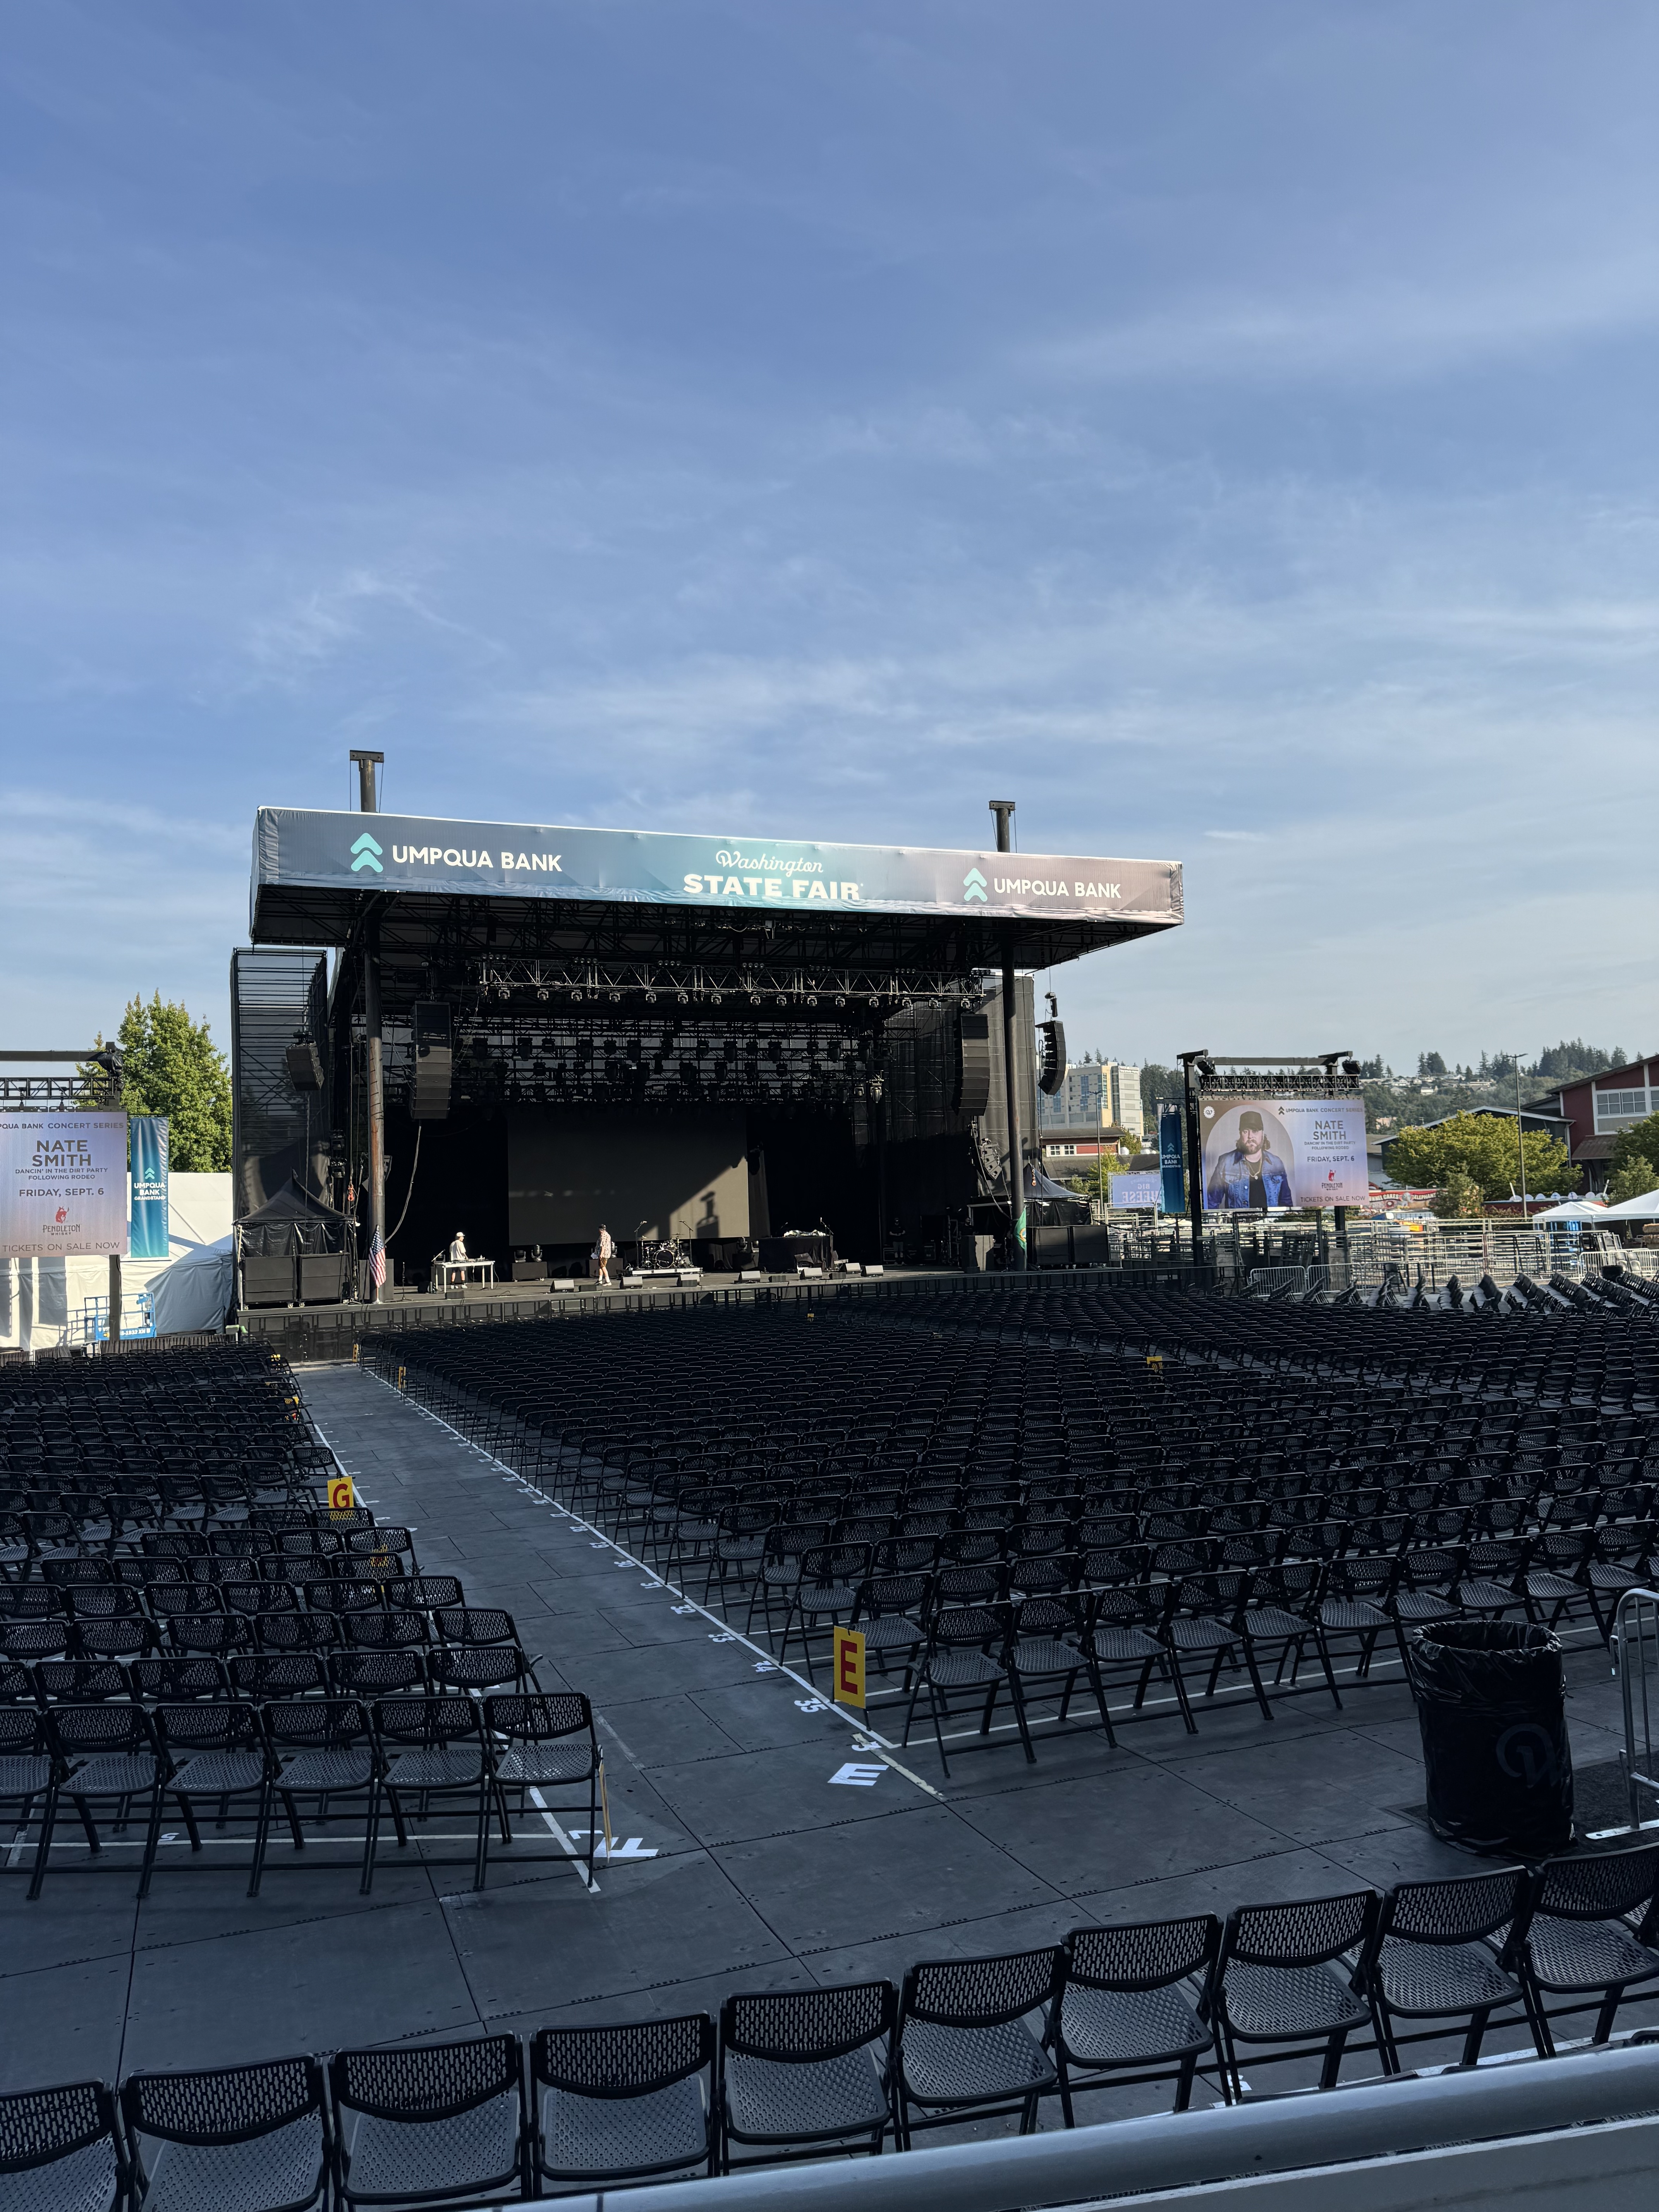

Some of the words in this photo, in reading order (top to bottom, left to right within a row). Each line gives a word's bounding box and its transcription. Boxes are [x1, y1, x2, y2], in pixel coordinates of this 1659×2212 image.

[393, 845, 493, 868] UMPQUA
[502, 852, 562, 872] BANK
[716, 850, 823, 877] Washington
[684, 874, 782, 897] STATE
[793, 879, 859, 900] FAIR
[994, 878, 1069, 896] UMPQUA
[1075, 882, 1121, 899] BANK
[1315, 1120, 1344, 1130] NATE
[1313, 1131, 1346, 1140] SMITH
[36, 1140, 88, 1152] NATE
[32, 1154, 91, 1166] SMITH
[19, 1189, 61, 1197] FRIDAY,
[43, 1224, 80, 1233] PENDLETON
[333, 1484, 350, 1508] G
[670, 1605, 696, 1614] 32
[708, 1633, 736, 1642] 33
[751, 1661, 778, 1672] 34
[841, 1640, 858, 1695] E
[794, 1698, 828, 1712] 35
[827, 1763, 889, 1786] E
